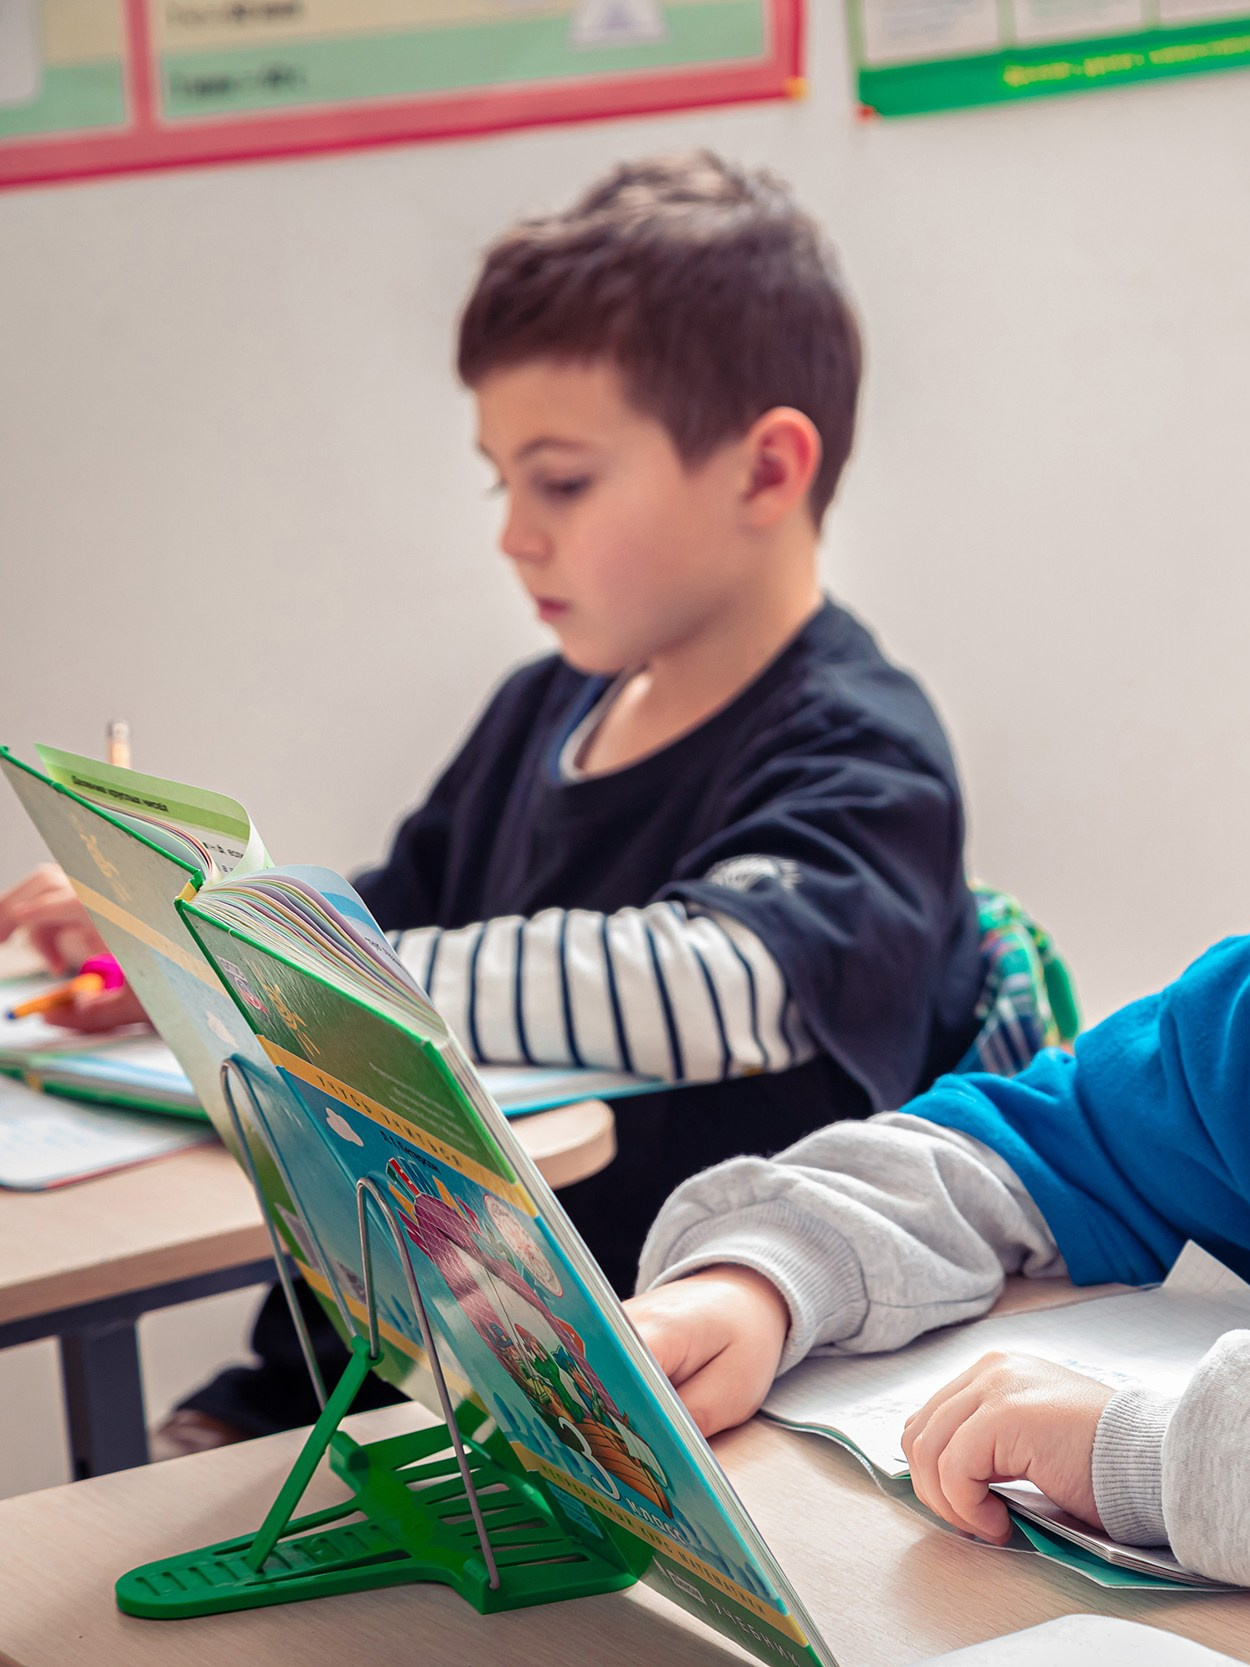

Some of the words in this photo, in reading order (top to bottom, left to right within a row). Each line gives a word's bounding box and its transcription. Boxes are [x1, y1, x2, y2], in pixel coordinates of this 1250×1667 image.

[316, 1074, 372, 1114] УЧУСЬ
[381, 1112, 462, 1167] УЧИТЬСЯ
[558, 1416, 620, 1500] 3
[710, 1599, 801, 1667] УЧЕБНИК
